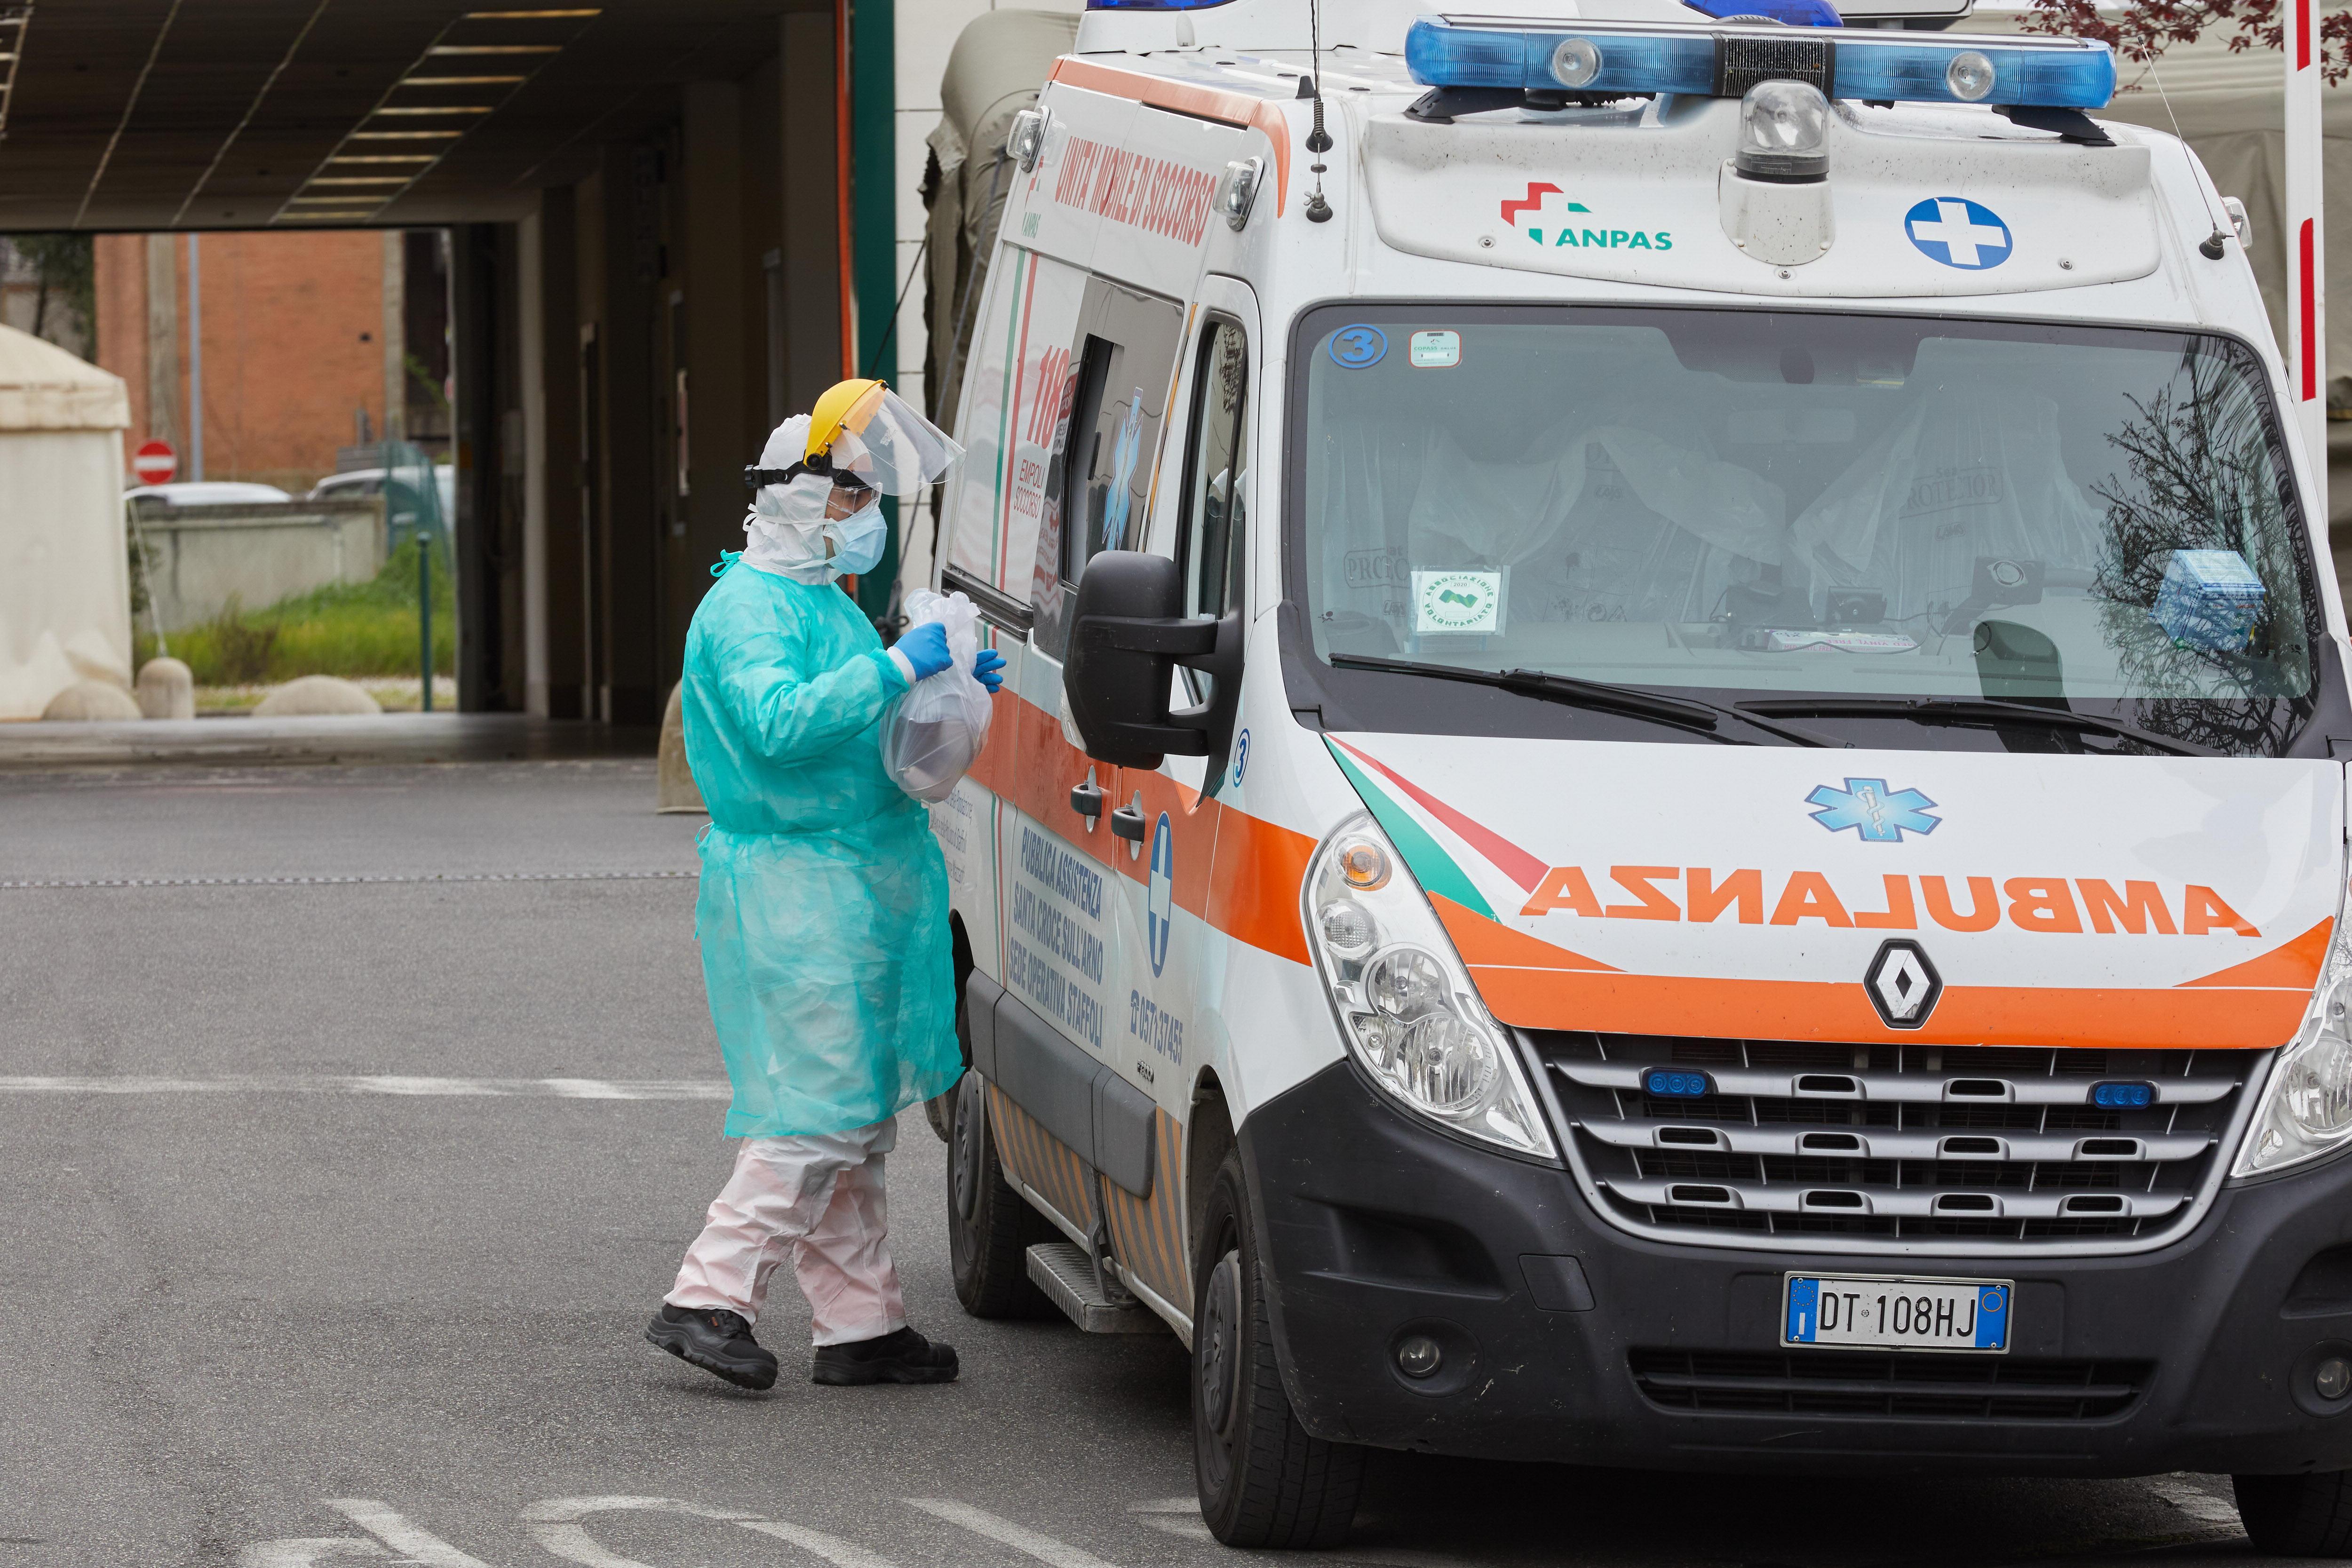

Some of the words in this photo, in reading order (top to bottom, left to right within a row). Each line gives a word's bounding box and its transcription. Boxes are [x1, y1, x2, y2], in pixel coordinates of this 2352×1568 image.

[1055, 135, 1103, 210] UNITA'
[1089, 145, 1143, 223] MOBILE
[1128, 157, 1155, 227] DI
[1142, 159, 1216, 247] SOCCORSO
[1023, 212, 1041, 239] ANPAS
[1555, 228, 1673, 251] ANPAS
[1342, 330, 1375, 363] 3
[1026, 345, 1070, 449] 118
[1019, 459, 1046, 489] EMPOLI
[1014, 486, 1041, 519] SOCCORSO
[1426, 575, 1494, 597] ASSOCIAZIONE
[1425, 603, 1493, 627] VOLONTARIATO
[1235, 738, 1247, 778] 3
[1021, 826, 1057, 890] PUBBLICA
[1056, 851, 1103, 922] ASSISTENZA
[1014, 881, 1035, 935] SANTA
[1037, 898, 1062, 956] CROCE
[1062, 915, 1104, 986] SULL'ARNO
[1009, 937, 1027, 990] SEDE
[1027, 952, 1066, 1021] OPERATIVA
[1066, 981, 1103, 1049] STAFFOLI
[1820, 1292, 1860, 1332] DT
[1877, 1295, 1976, 1337] 108HJ
